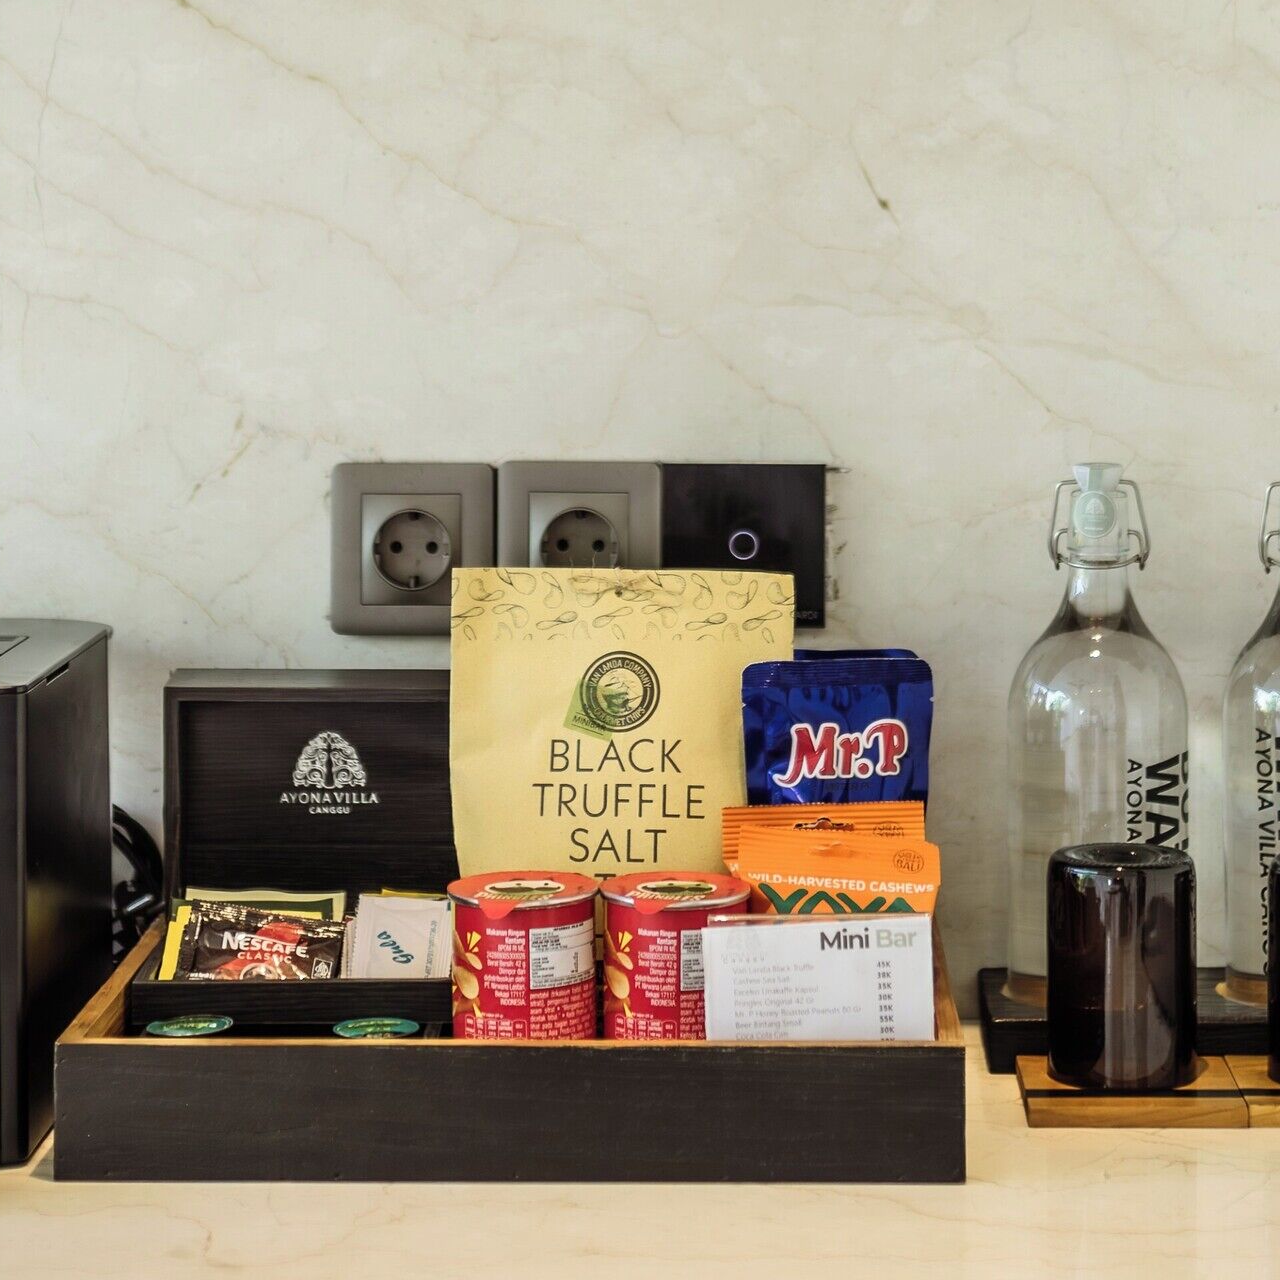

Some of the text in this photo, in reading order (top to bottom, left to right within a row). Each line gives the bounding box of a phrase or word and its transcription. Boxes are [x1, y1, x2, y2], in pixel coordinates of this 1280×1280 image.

[623, 660, 653, 689] COMPANY
[549, 738, 683, 773] BLACK
[1255, 727, 1274, 811] AYONA
[280, 792, 380, 804] AYONA VILLA
[308, 806, 351, 815] CANGGU
[532, 783, 706, 819] TRUFFLE
[1126, 758, 1143, 842] AYONA
[569, 828, 667, 864] SALT
[748, 872, 935, 894] WILD-HARVESTED CASHEWS
[820, 927, 918, 951] Mini Bar
